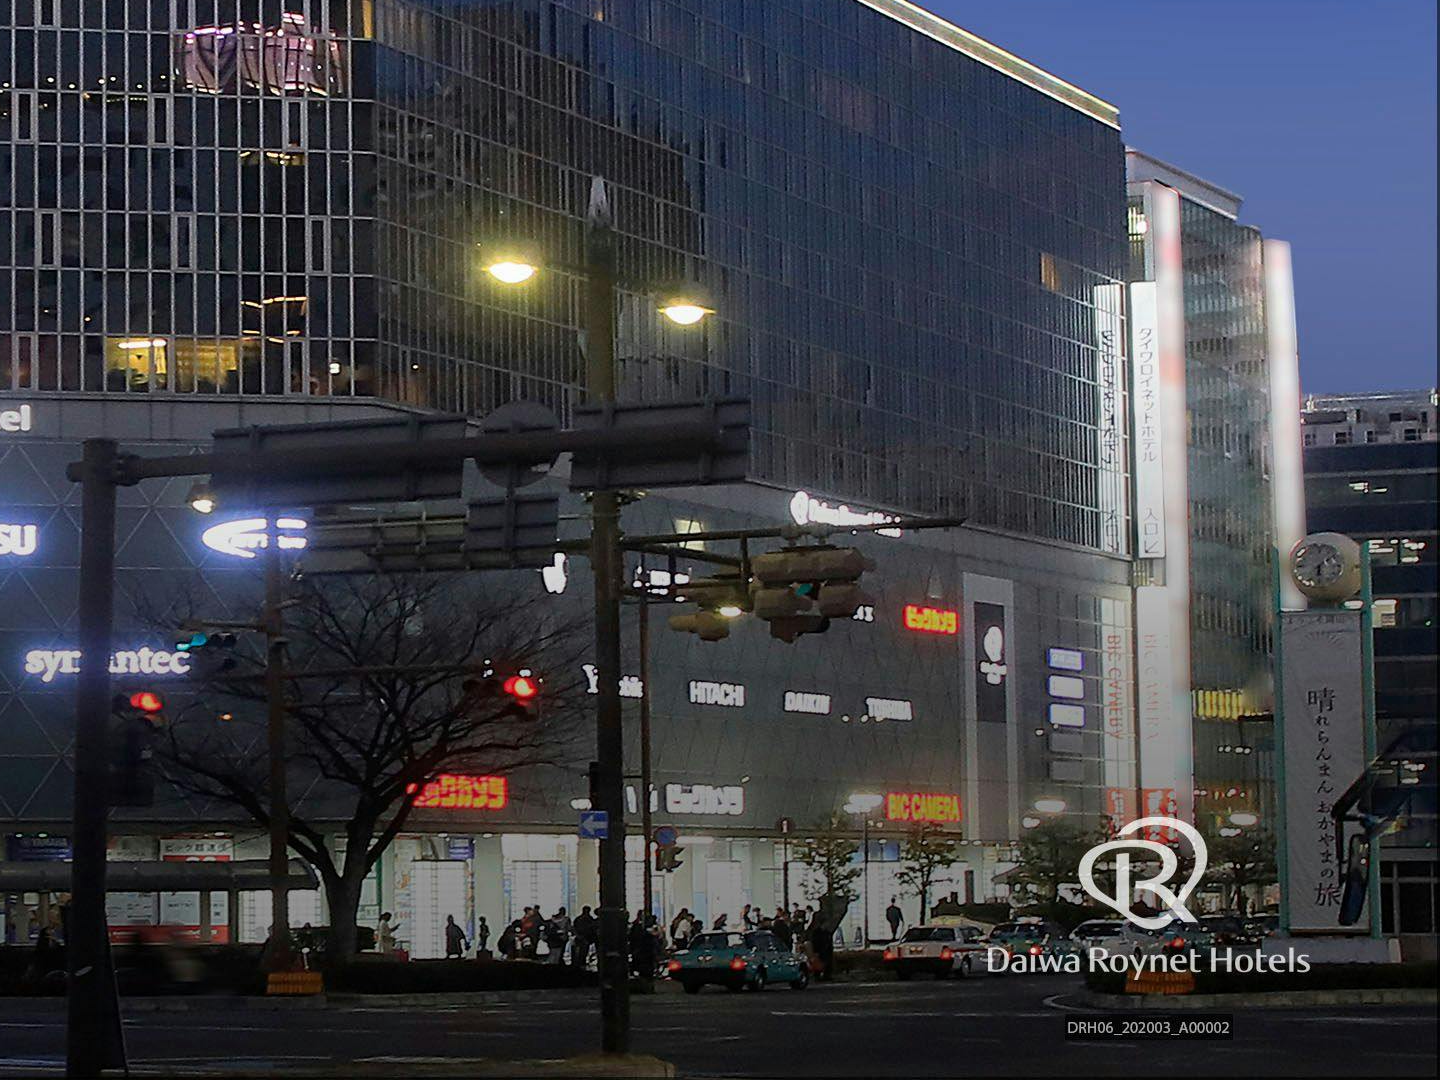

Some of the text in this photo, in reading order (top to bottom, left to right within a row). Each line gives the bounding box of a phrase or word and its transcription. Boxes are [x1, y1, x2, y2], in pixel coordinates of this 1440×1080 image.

[1138, 326, 1159, 537] ダイワロイネットホテル 入口
[25, 646, 191, 682] syntec
[690, 681, 744, 707] HITACHI
[1307, 686, 1336, 795] 晴れらんまん
[886, 792, 961, 823] BIC CAMERA
